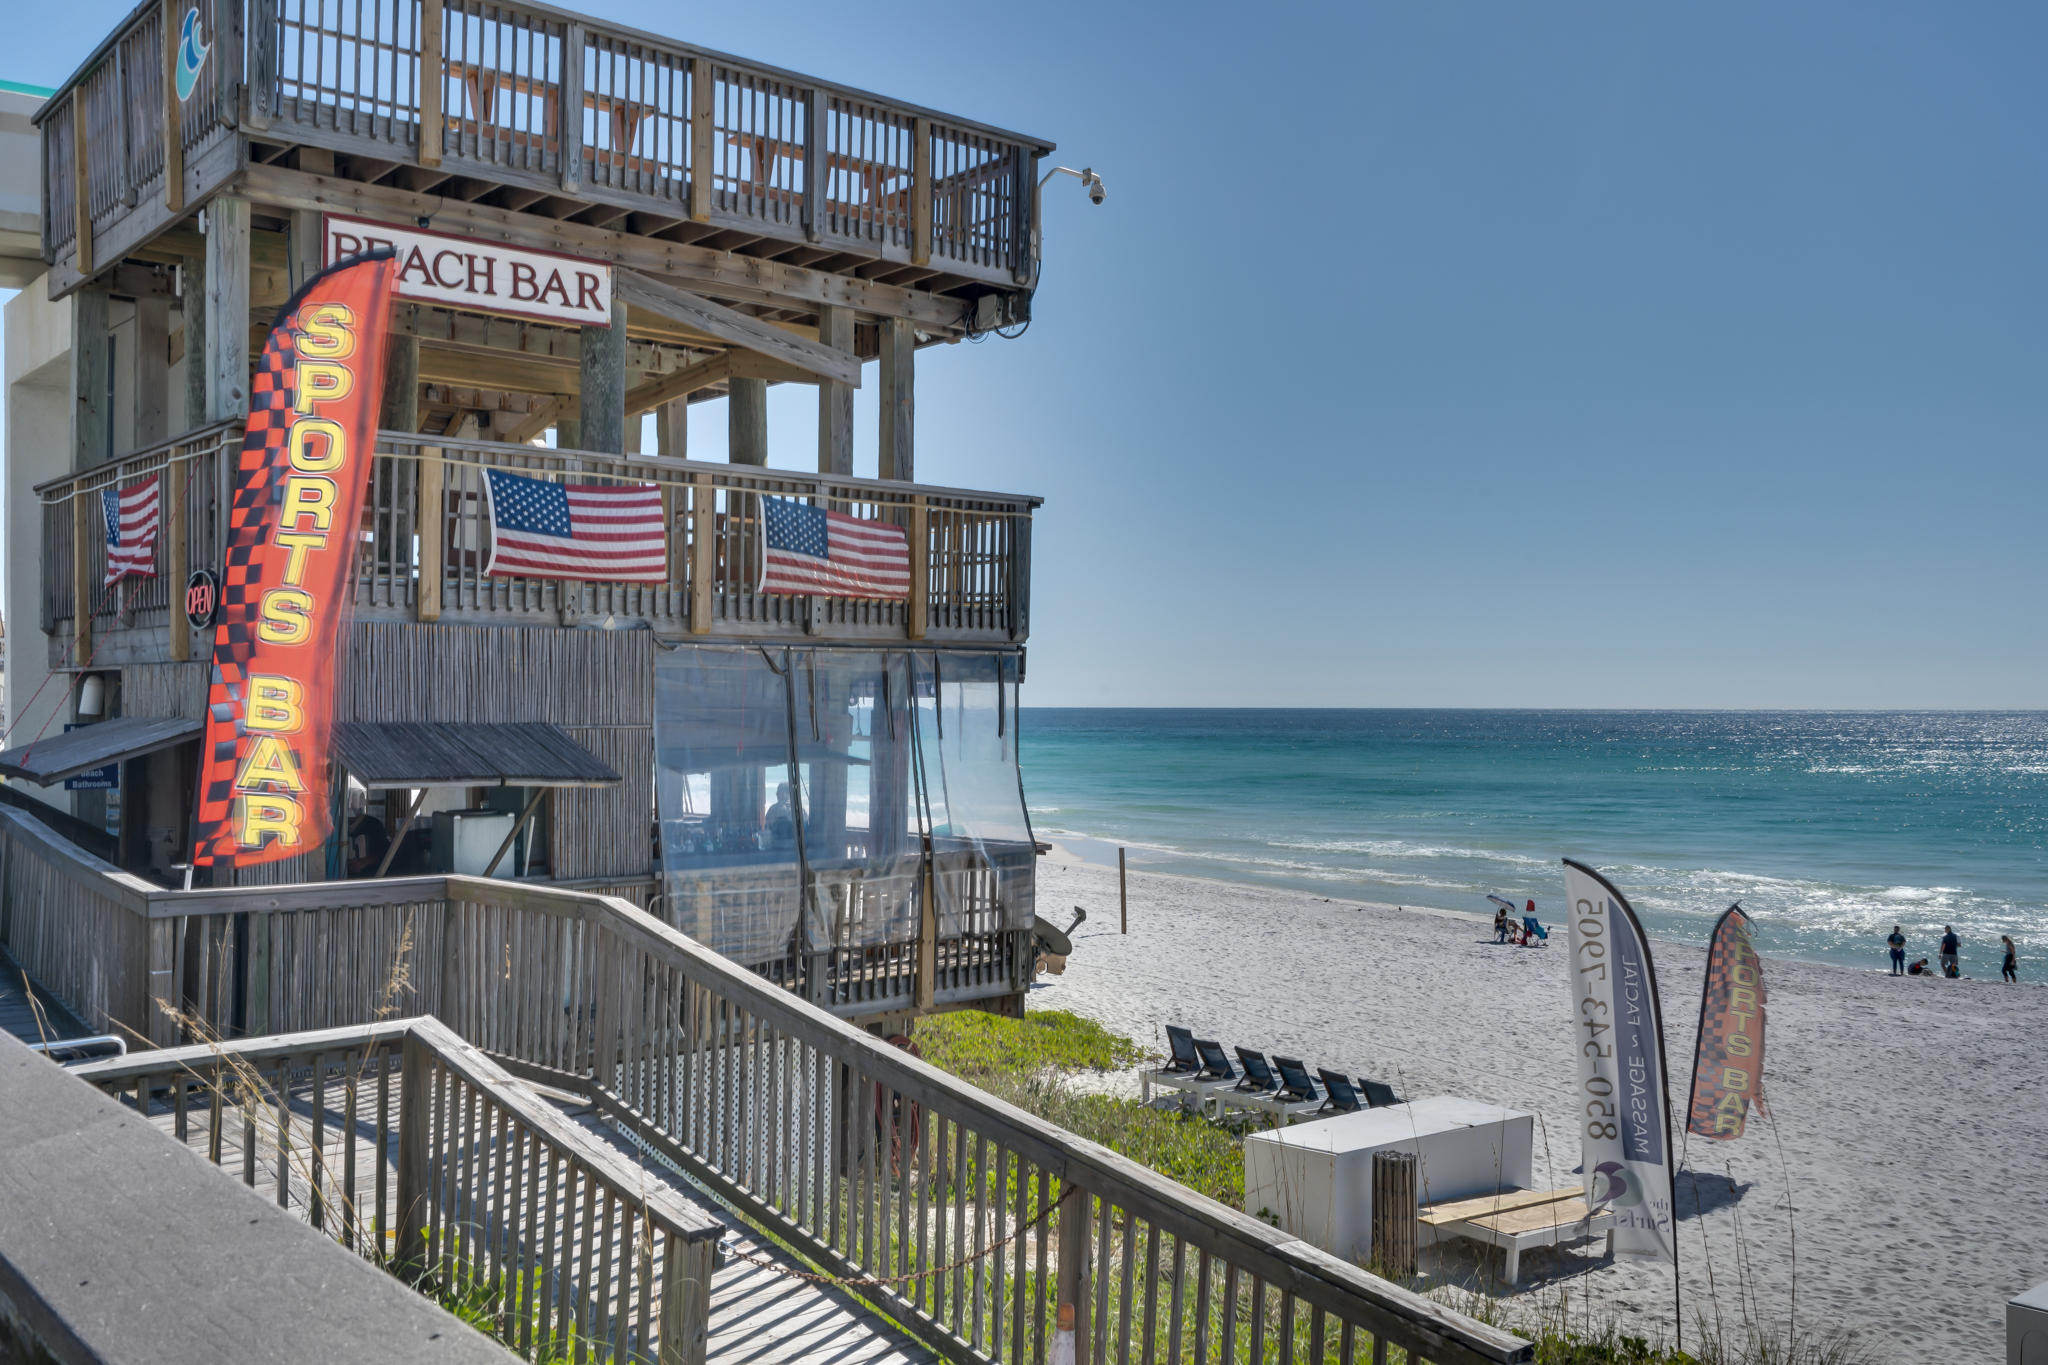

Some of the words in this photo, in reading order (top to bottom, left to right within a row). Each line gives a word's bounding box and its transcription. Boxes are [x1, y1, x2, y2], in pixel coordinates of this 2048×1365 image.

[332, 231, 497, 296] BACH
[509, 261, 605, 312] BAR
[256, 303, 356, 646] SPORTS
[186, 584, 213, 615] OPEN
[72, 780, 112, 789] Bathrooms
[231, 673, 309, 850] BAR
[1715, 1067, 1750, 1137] BAR
